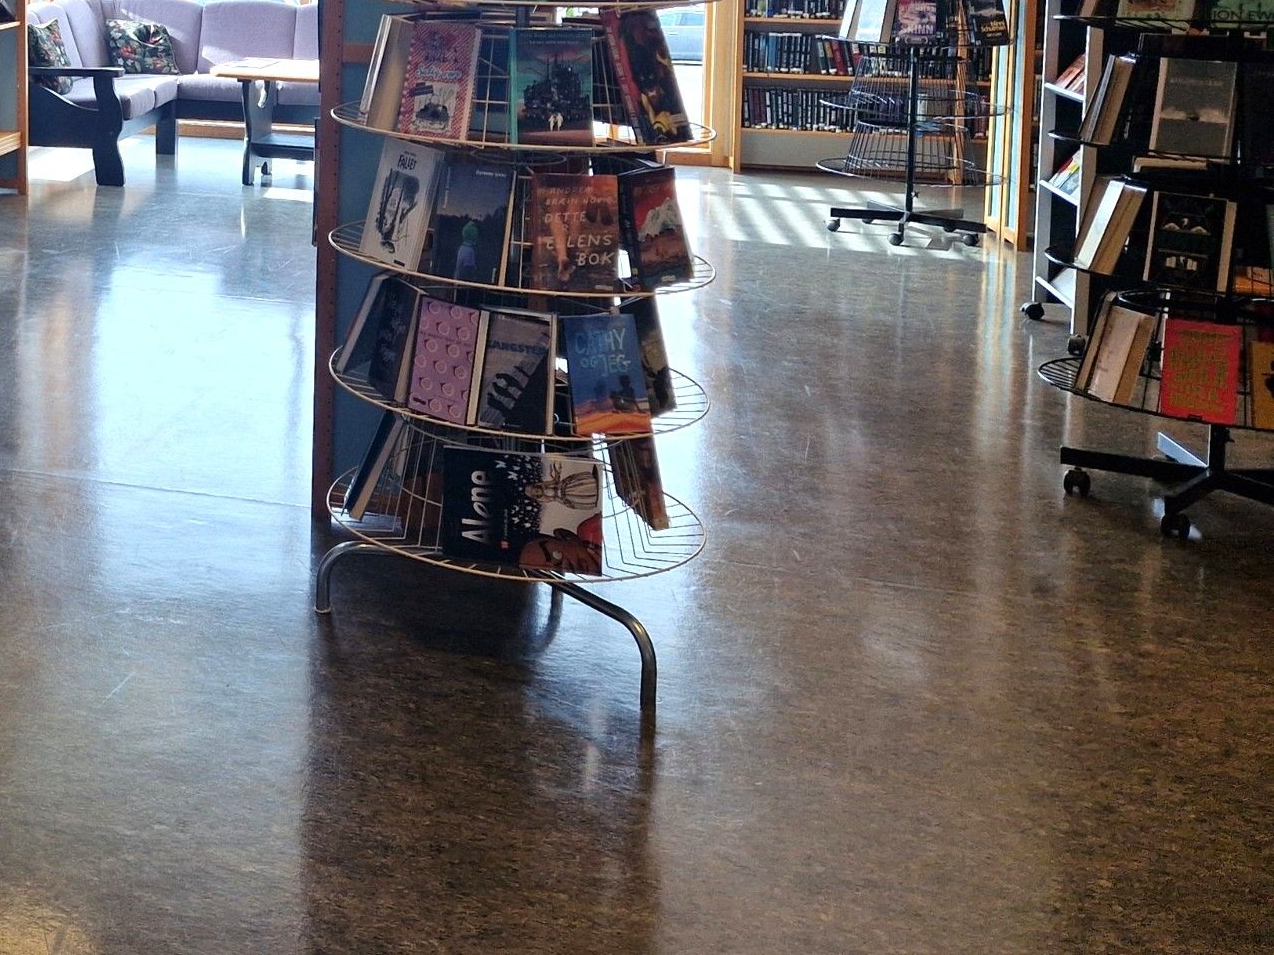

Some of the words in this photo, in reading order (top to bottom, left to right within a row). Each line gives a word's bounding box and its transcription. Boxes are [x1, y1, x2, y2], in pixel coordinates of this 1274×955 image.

[396, 154, 418, 171] FALLET
[544, 211, 587, 223] DETTE
[545, 234, 614, 250] ELENS
[577, 251, 616, 267] BOK
[575, 328, 626, 355] CATHY
[461, 470, 492, 545] Alene
